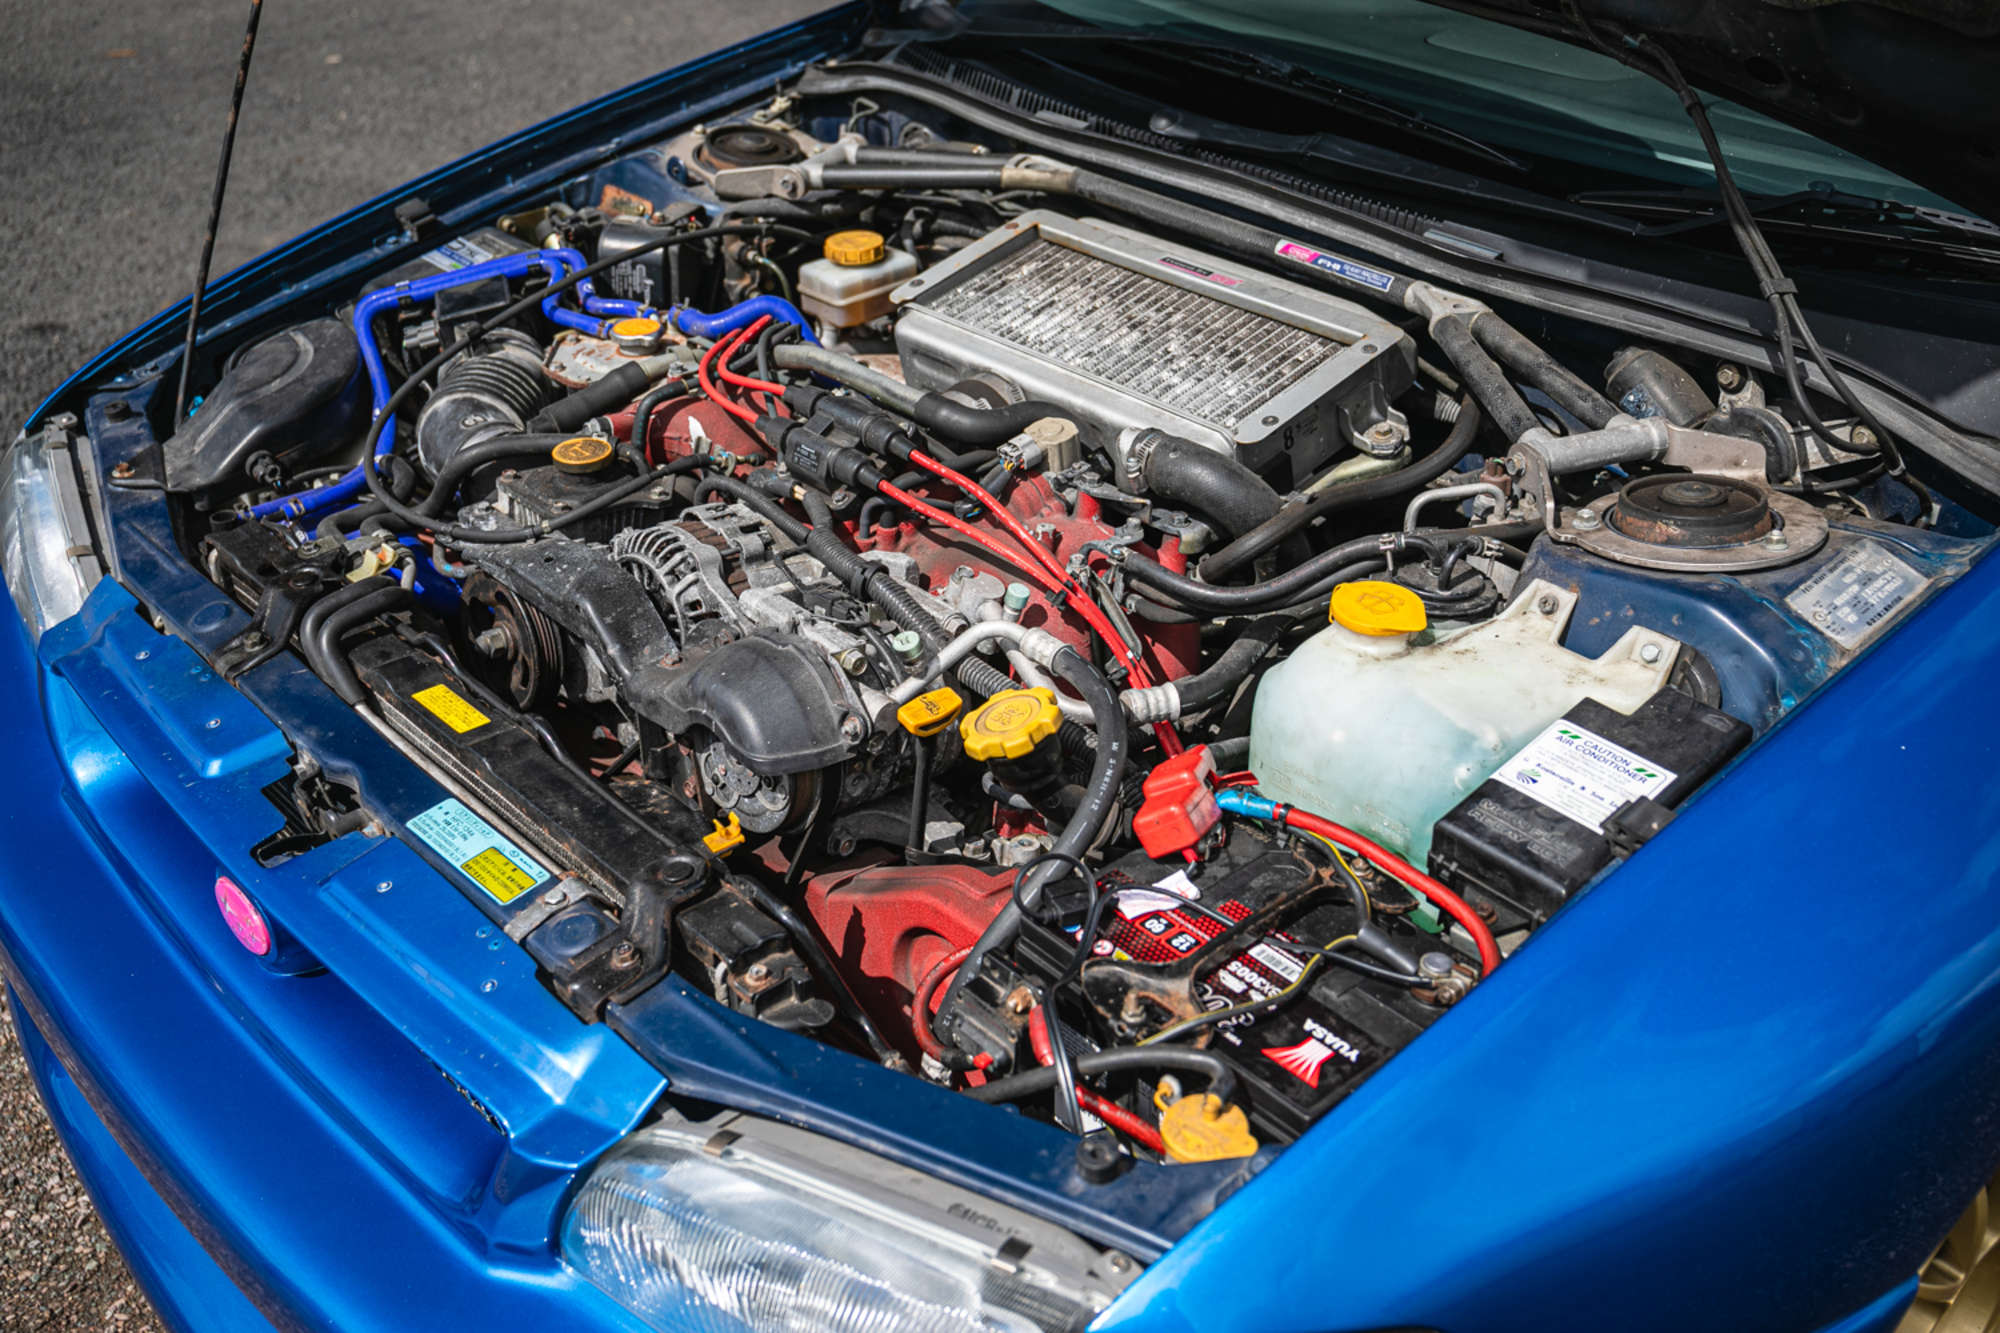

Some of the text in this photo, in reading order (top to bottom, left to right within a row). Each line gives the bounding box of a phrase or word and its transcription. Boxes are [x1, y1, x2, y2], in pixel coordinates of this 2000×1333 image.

[1555, 735, 1575, 747] AIR
[1575, 744, 1648, 784] CONDITIONER
[1583, 739, 1632, 767] CAUTION
[1144, 917, 1166, 934] 60
[1171, 935, 1191, 951] 12
[1303, 1017, 1360, 1063] YUASA
